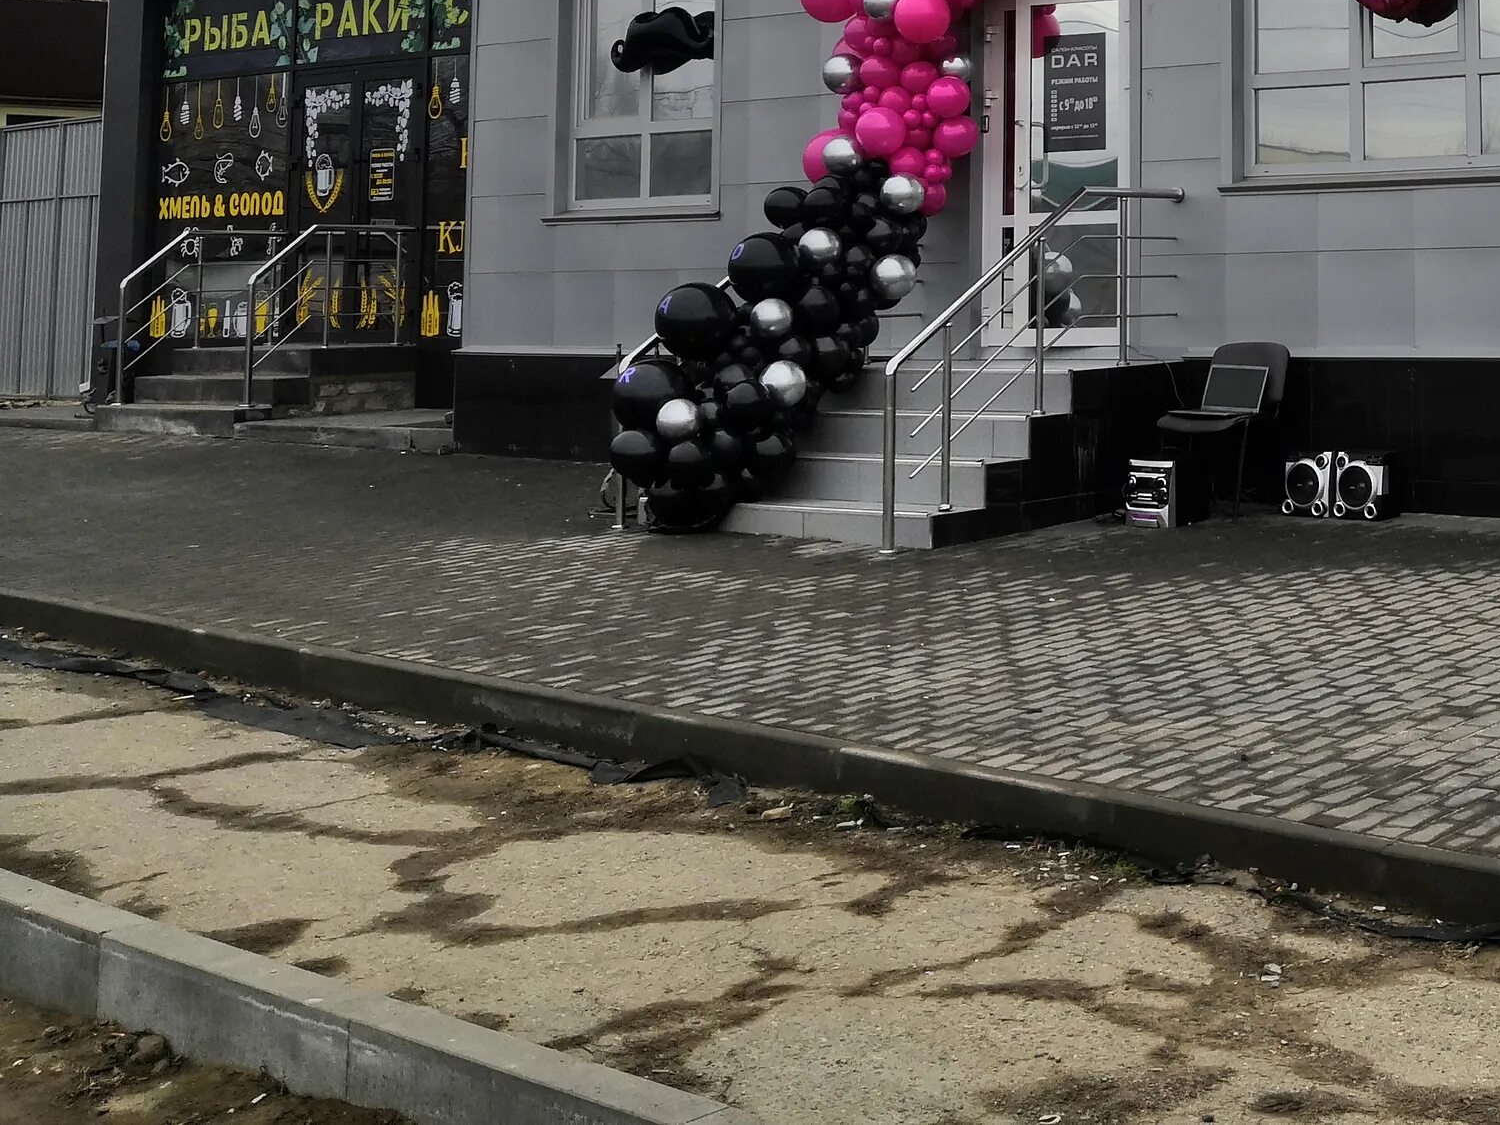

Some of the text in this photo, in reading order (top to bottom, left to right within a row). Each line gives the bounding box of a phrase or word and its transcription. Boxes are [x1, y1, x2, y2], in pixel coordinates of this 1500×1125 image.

[184, 10, 271, 54] РЫБА
[1051, 53, 1098, 69] DAR
[159, 190, 284, 220] ХМЕЛЬ & СОЛОД
